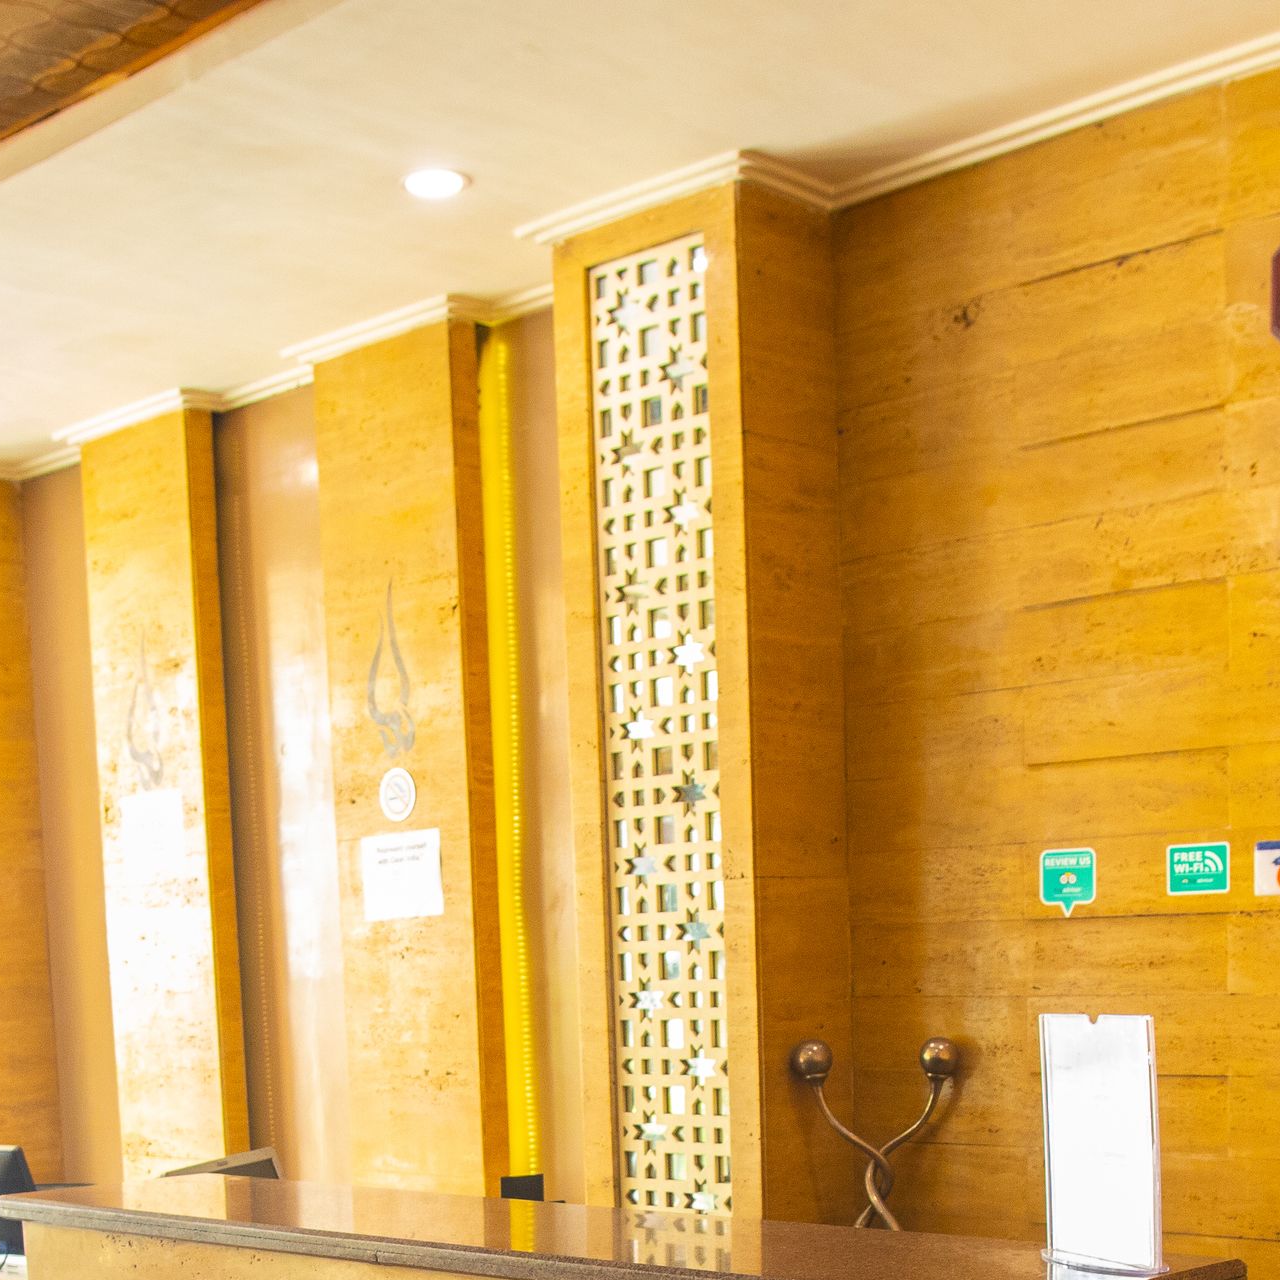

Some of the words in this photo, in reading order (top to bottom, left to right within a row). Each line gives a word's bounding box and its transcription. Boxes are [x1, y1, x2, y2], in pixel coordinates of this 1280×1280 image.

[1045, 856, 1077, 868] REVIEW
[1078, 854, 1092, 866] US
[1174, 851, 1203, 863] FREE
[1174, 863, 1204, 874] WI-FI
